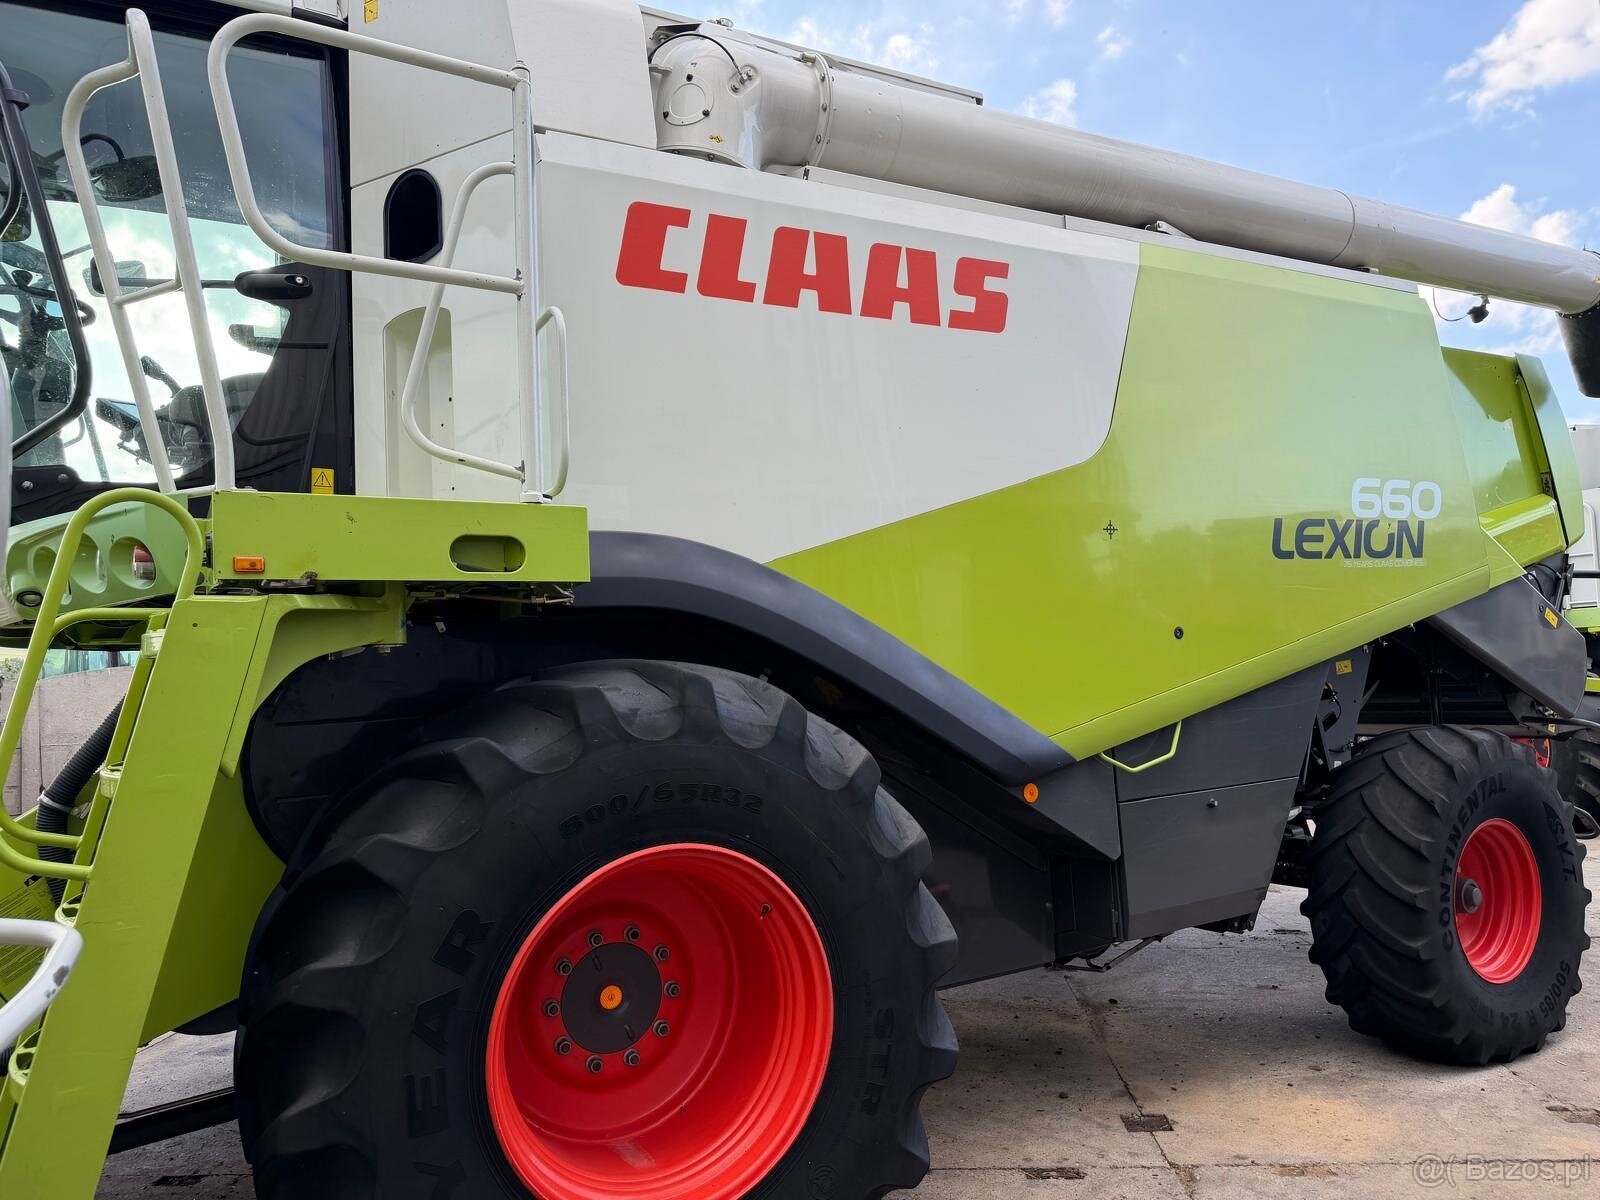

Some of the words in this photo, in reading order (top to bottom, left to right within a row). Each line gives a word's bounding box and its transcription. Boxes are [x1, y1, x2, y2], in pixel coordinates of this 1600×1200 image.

[616, 201, 1009, 333] CLAAS
[1272, 518, 1425, 559] LEXION
[1352, 479, 1441, 519] 660
[1439, 773, 1507, 951] CONTINENTAL
